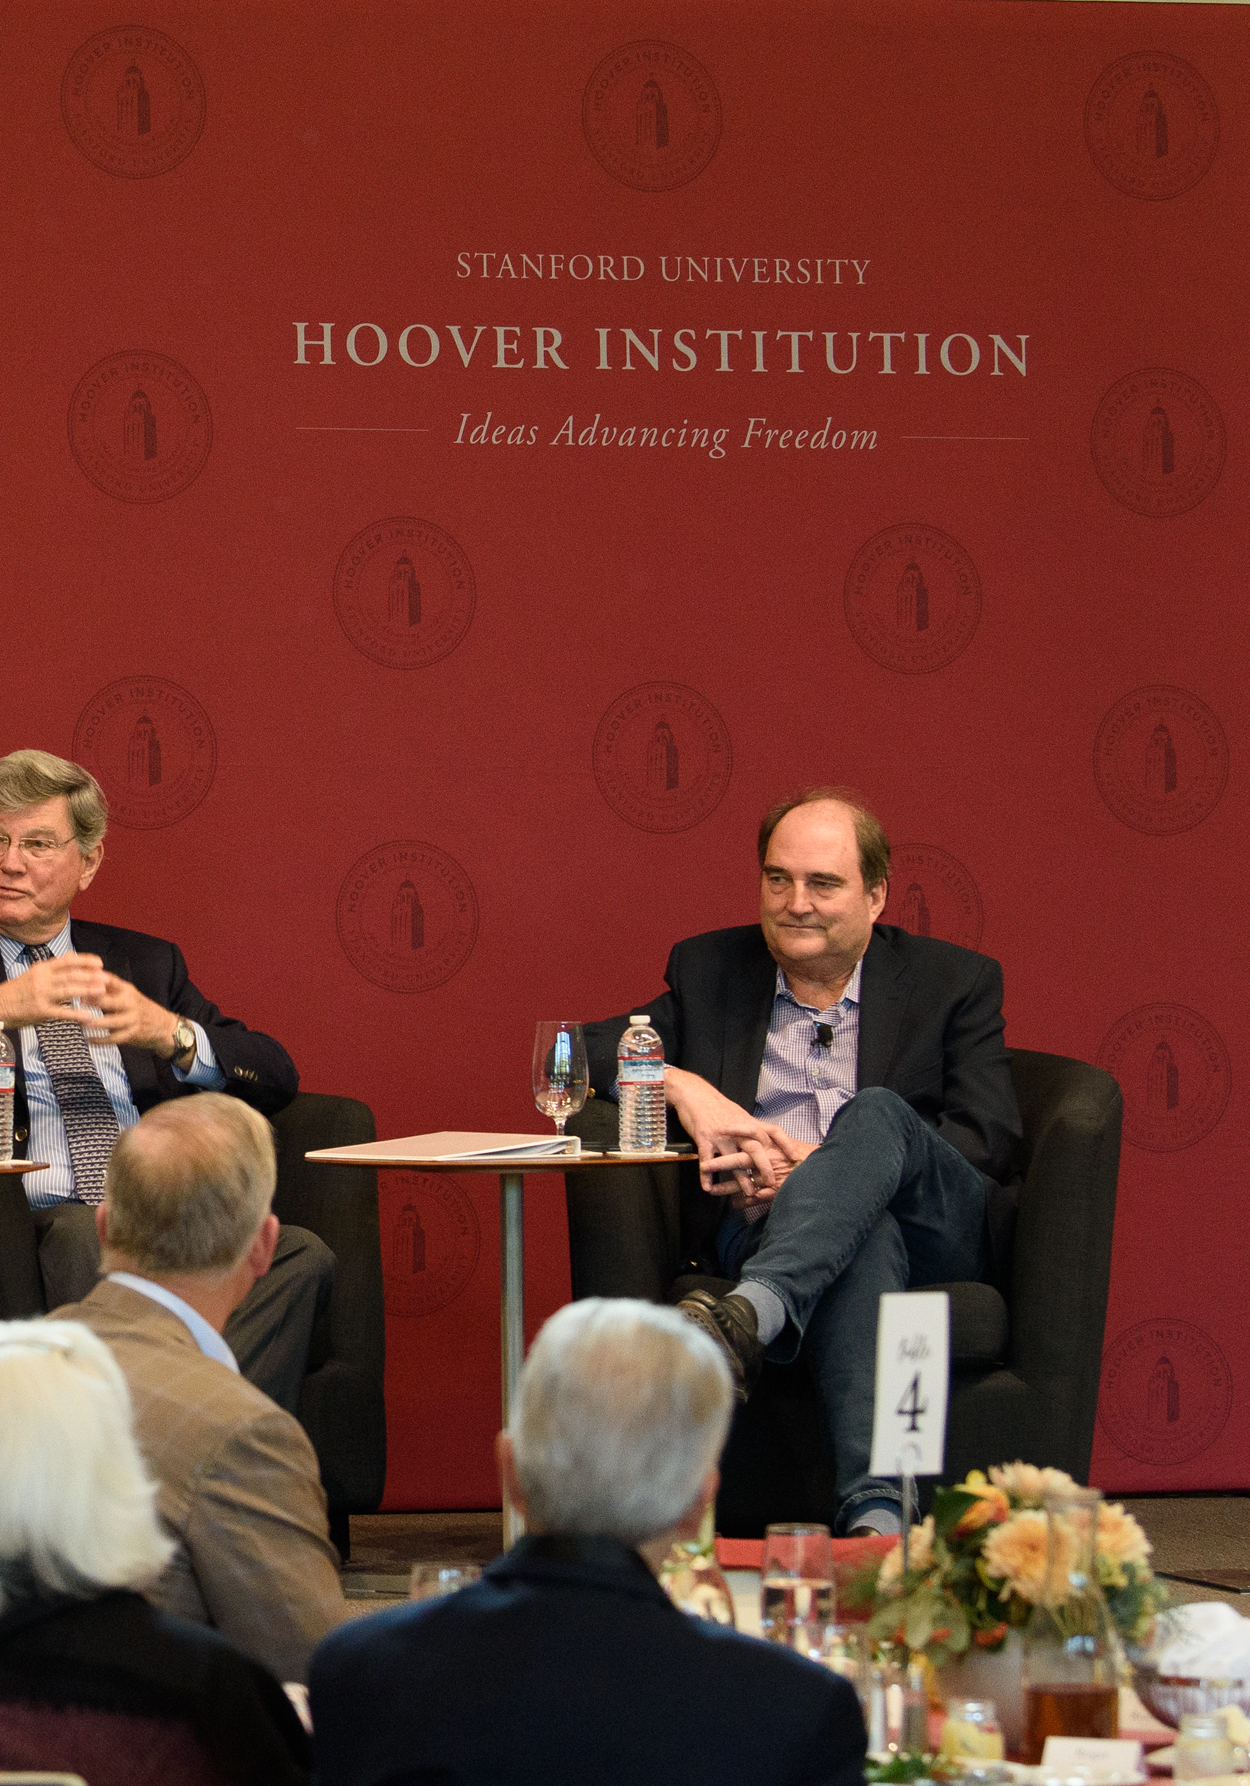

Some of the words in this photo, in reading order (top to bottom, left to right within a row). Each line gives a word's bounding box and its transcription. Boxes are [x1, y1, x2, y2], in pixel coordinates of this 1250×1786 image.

[73, 42, 112, 97] HOOVER
[118, 37, 194, 99] INSTITUTION
[594, 56, 631, 111] HOOVER
[637, 52, 710, 113] INSTITUTION
[1095, 67, 1132, 121] HOOVER
[1137, 62, 1208, 123] INSTITUTION
[457, 253, 644, 280] STANFORD
[661, 257, 870, 284] UNIVERSITY
[293, 322, 569, 369] HOOVER
[595, 328, 1029, 376] INSTITUTION
[79, 367, 118, 422] HOOVER
[124, 362, 201, 424] INSTITUTION
[1102, 384, 1139, 438] HOOVER
[1144, 379, 1215, 440] INSTITUTION
[454, 412, 538, 445] Ideas
[550, 414, 729, 459] Advancing
[741, 417, 877, 449] Freedom
[345, 533, 383, 588] HOOVER
[389, 529, 464, 590] INSTITUTION
[856, 539, 893, 594] HOOVER
[898, 534, 970, 596] INSTITUTION
[84, 693, 124, 749] HOOVER
[130, 687, 206, 748] INSTITUTION
[604, 698, 642, 753] HOOVER
[648, 693, 721, 754] INSTITUTION
[1104, 701, 1141, 756] HOOVER
[1146, 697, 1218, 757] INSTITUTION
[348, 857, 386, 912] HOOVER
[392, 852, 467, 914] INSTITUTION
[900, 854, 973, 915] INSTITUTION
[1148, 1014, 1220, 1073] INSTITUTION
[395, 1176, 469, 1236] INSTITUTION
[1105, 1336, 1144, 1389] HOOVER
[1150, 1329, 1222, 1387] INSTITUTION
[895, 1370, 929, 1433] 4
